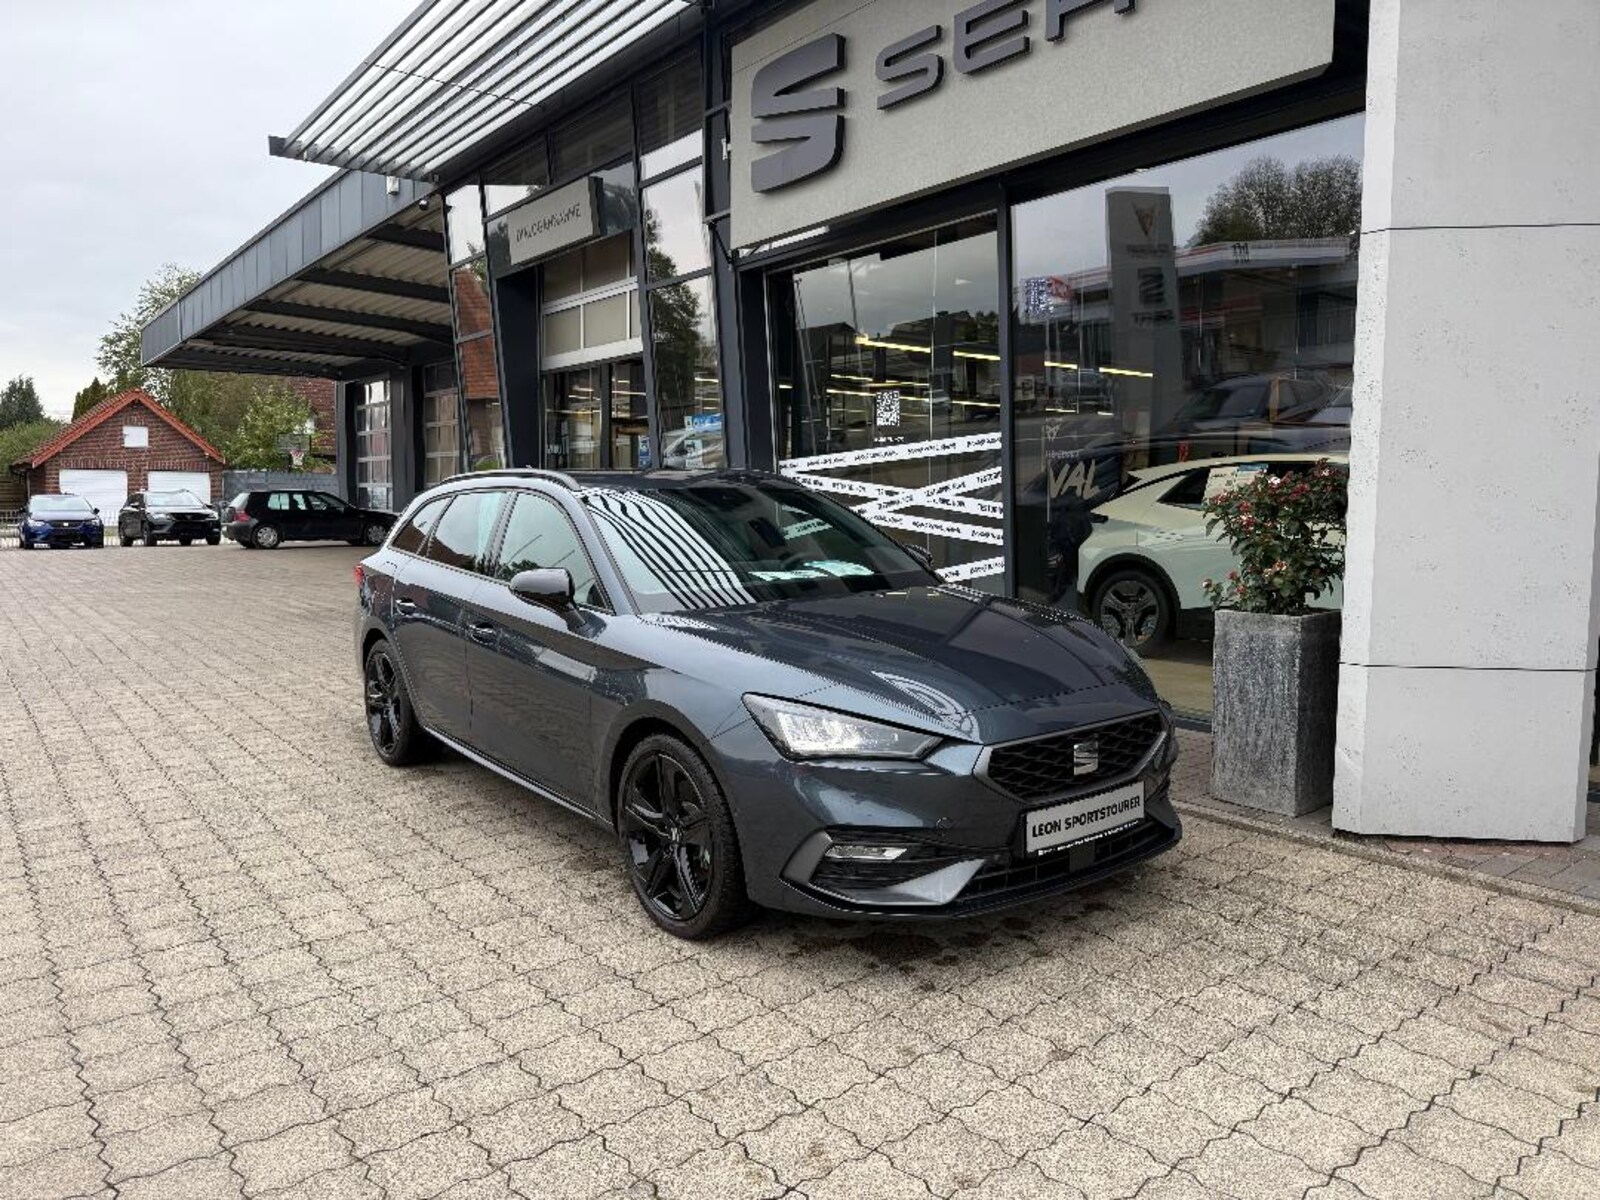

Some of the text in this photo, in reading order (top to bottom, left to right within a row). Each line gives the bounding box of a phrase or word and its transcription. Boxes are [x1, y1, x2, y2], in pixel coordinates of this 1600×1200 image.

[876, 0, 1136, 109] SE
[1032, 819, 1062, 838] LEON
[1065, 796, 1141, 830] SPORTSTOURER
